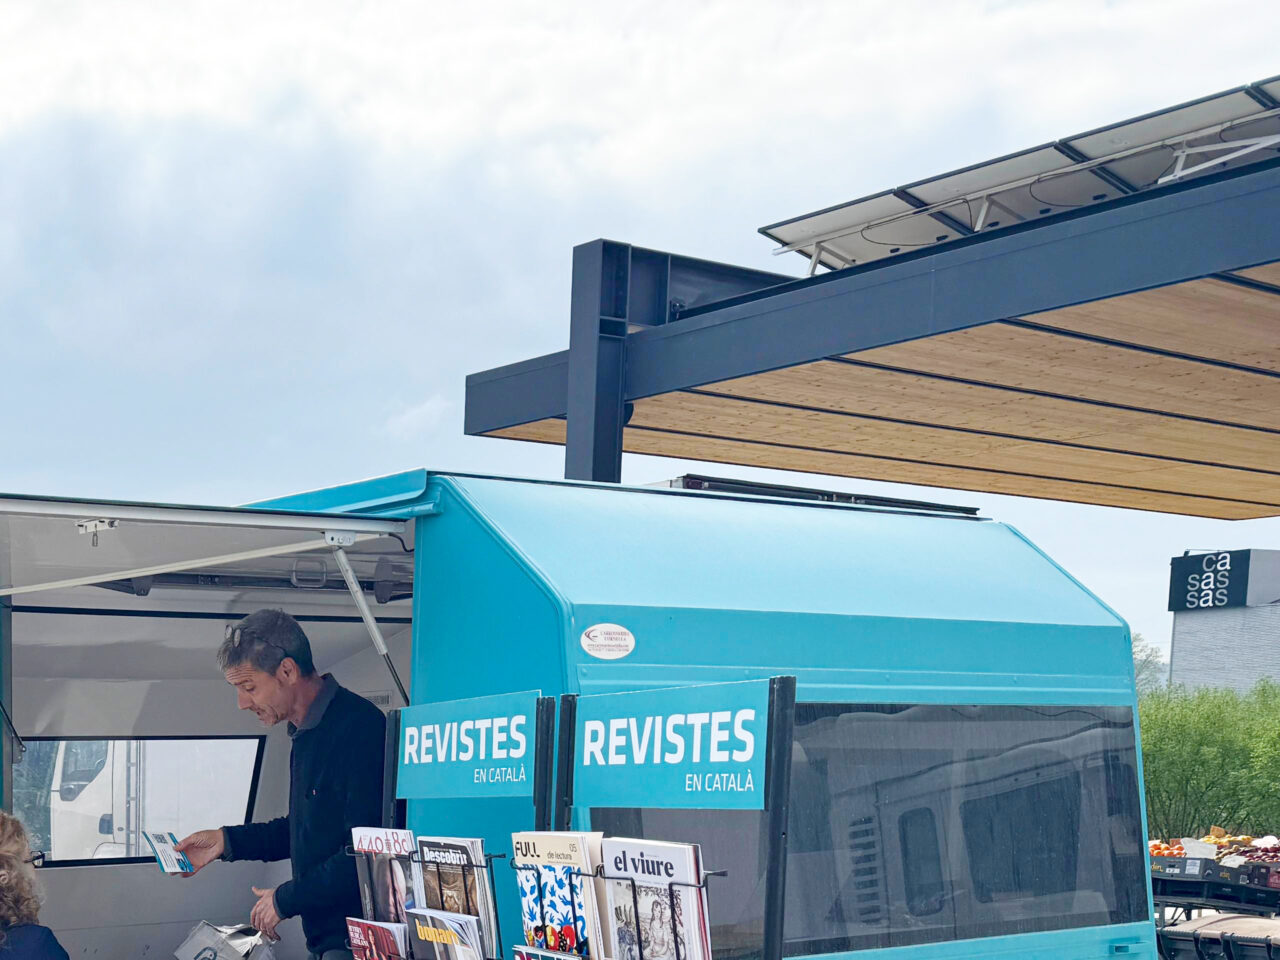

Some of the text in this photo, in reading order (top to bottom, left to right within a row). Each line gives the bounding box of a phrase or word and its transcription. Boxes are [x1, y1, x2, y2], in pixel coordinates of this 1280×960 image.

[1202, 552, 1232, 572] ca
[1186, 571, 1229, 591] sas
[1185, 588, 1228, 608] sas
[404, 714, 527, 765] REVISTES
[583, 709, 756, 766] REVISTES
[474, 763, 526, 783] EN CATALÀ
[685, 769, 755, 792] EN CATALÀ
[422, 846, 468, 865] Descobrir
[514, 841, 540, 858] FULL
[614, 850, 675, 878] el viure
